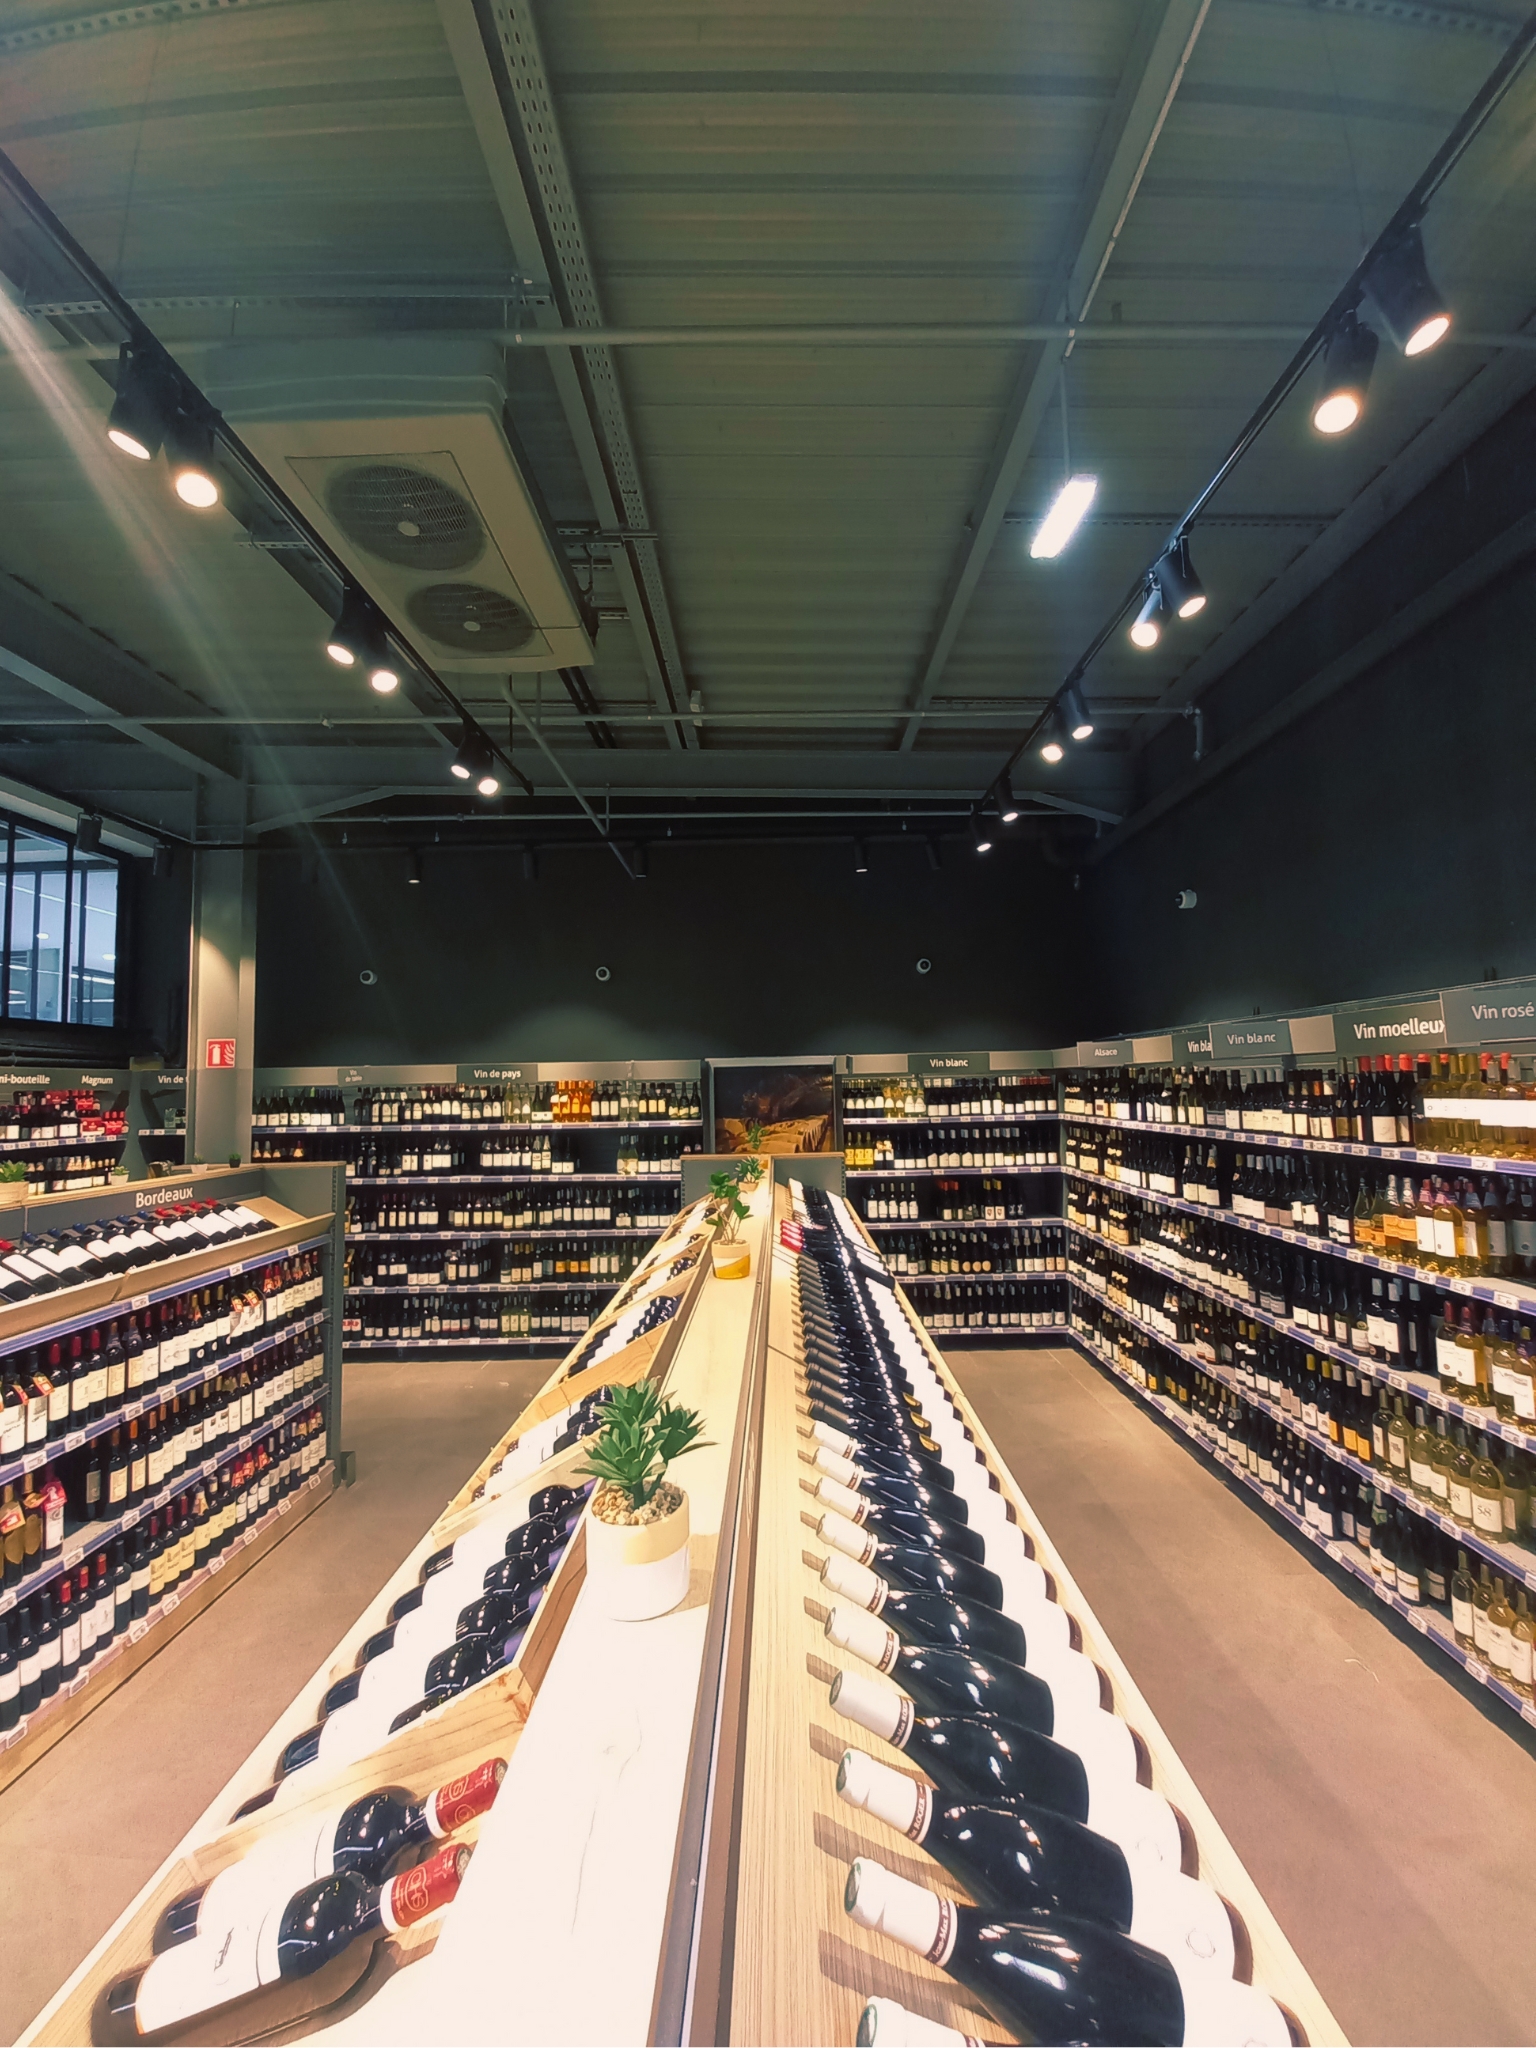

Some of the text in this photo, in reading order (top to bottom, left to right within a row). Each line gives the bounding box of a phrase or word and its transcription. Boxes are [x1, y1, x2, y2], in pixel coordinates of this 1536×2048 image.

[1471, 1002, 1535, 1020] Vin rosé
[1353, 1023, 1377, 1040] Vin
[1226, 1032, 1277, 1046] Vin blanc
[1094, 1047, 1118, 1057] Alsace
[1187, 1041, 1199, 1053] Vin
[929, 1058, 969, 1068] Vin blanc
[81, 1075, 114, 1087] Magnum
[157, 1075, 172, 1084] Vin
[173, 1075, 184, 1084] de
[473, 1069, 522, 1081] Vin de pays
[135, 1186, 194, 1209] Bordeaux
